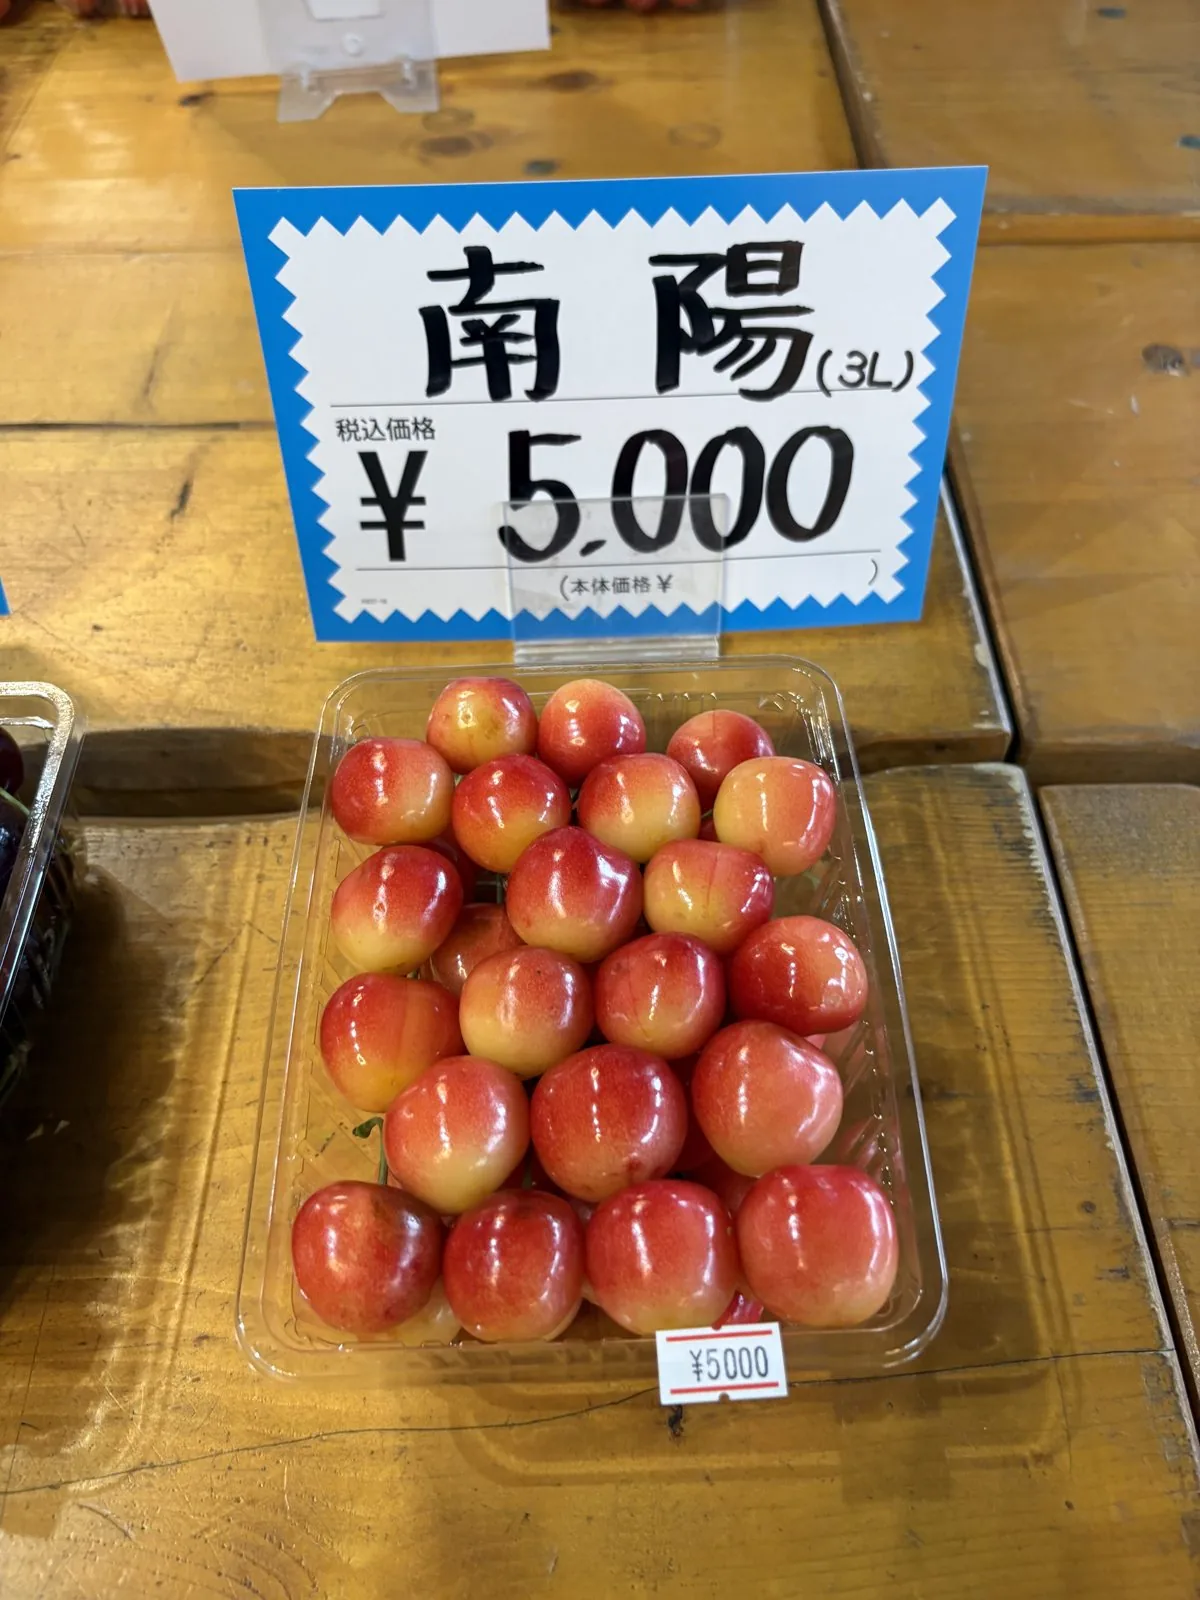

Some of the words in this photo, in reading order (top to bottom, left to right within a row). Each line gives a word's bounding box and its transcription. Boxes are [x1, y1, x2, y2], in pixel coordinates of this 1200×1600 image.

[816, 349, 914, 398] (3L)
[336, 417, 436, 442] 税込価格
[689, 1345, 768, 1382] ¥5000
